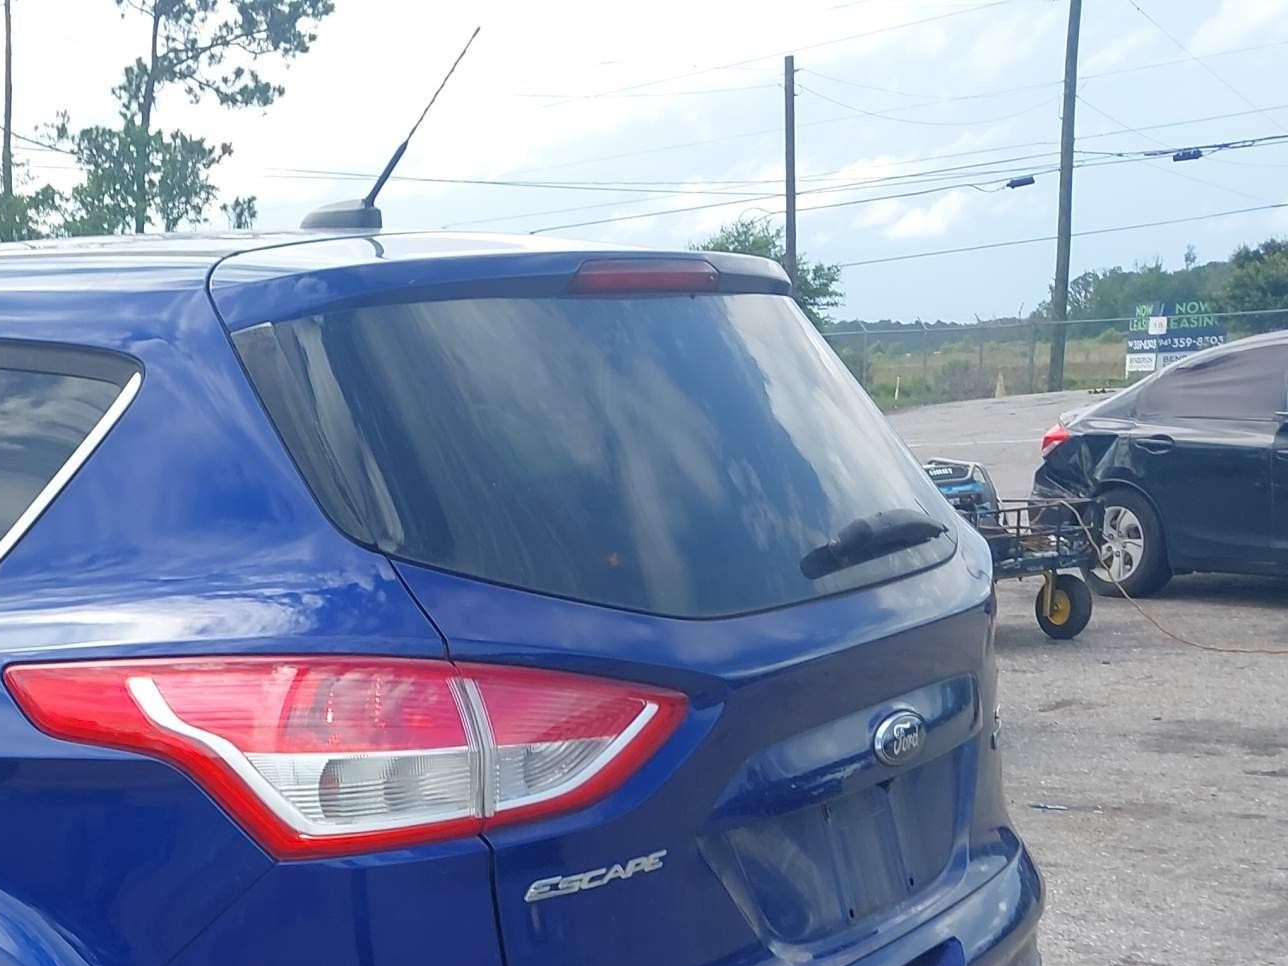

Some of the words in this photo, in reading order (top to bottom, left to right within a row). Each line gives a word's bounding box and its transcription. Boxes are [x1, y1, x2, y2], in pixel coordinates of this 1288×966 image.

[1136, 304, 1153, 317] NOW
[1175, 301, 1214, 315] NOW
[893, 722, 919, 756] Ford
[524, 850, 667, 902] ESCAPE
